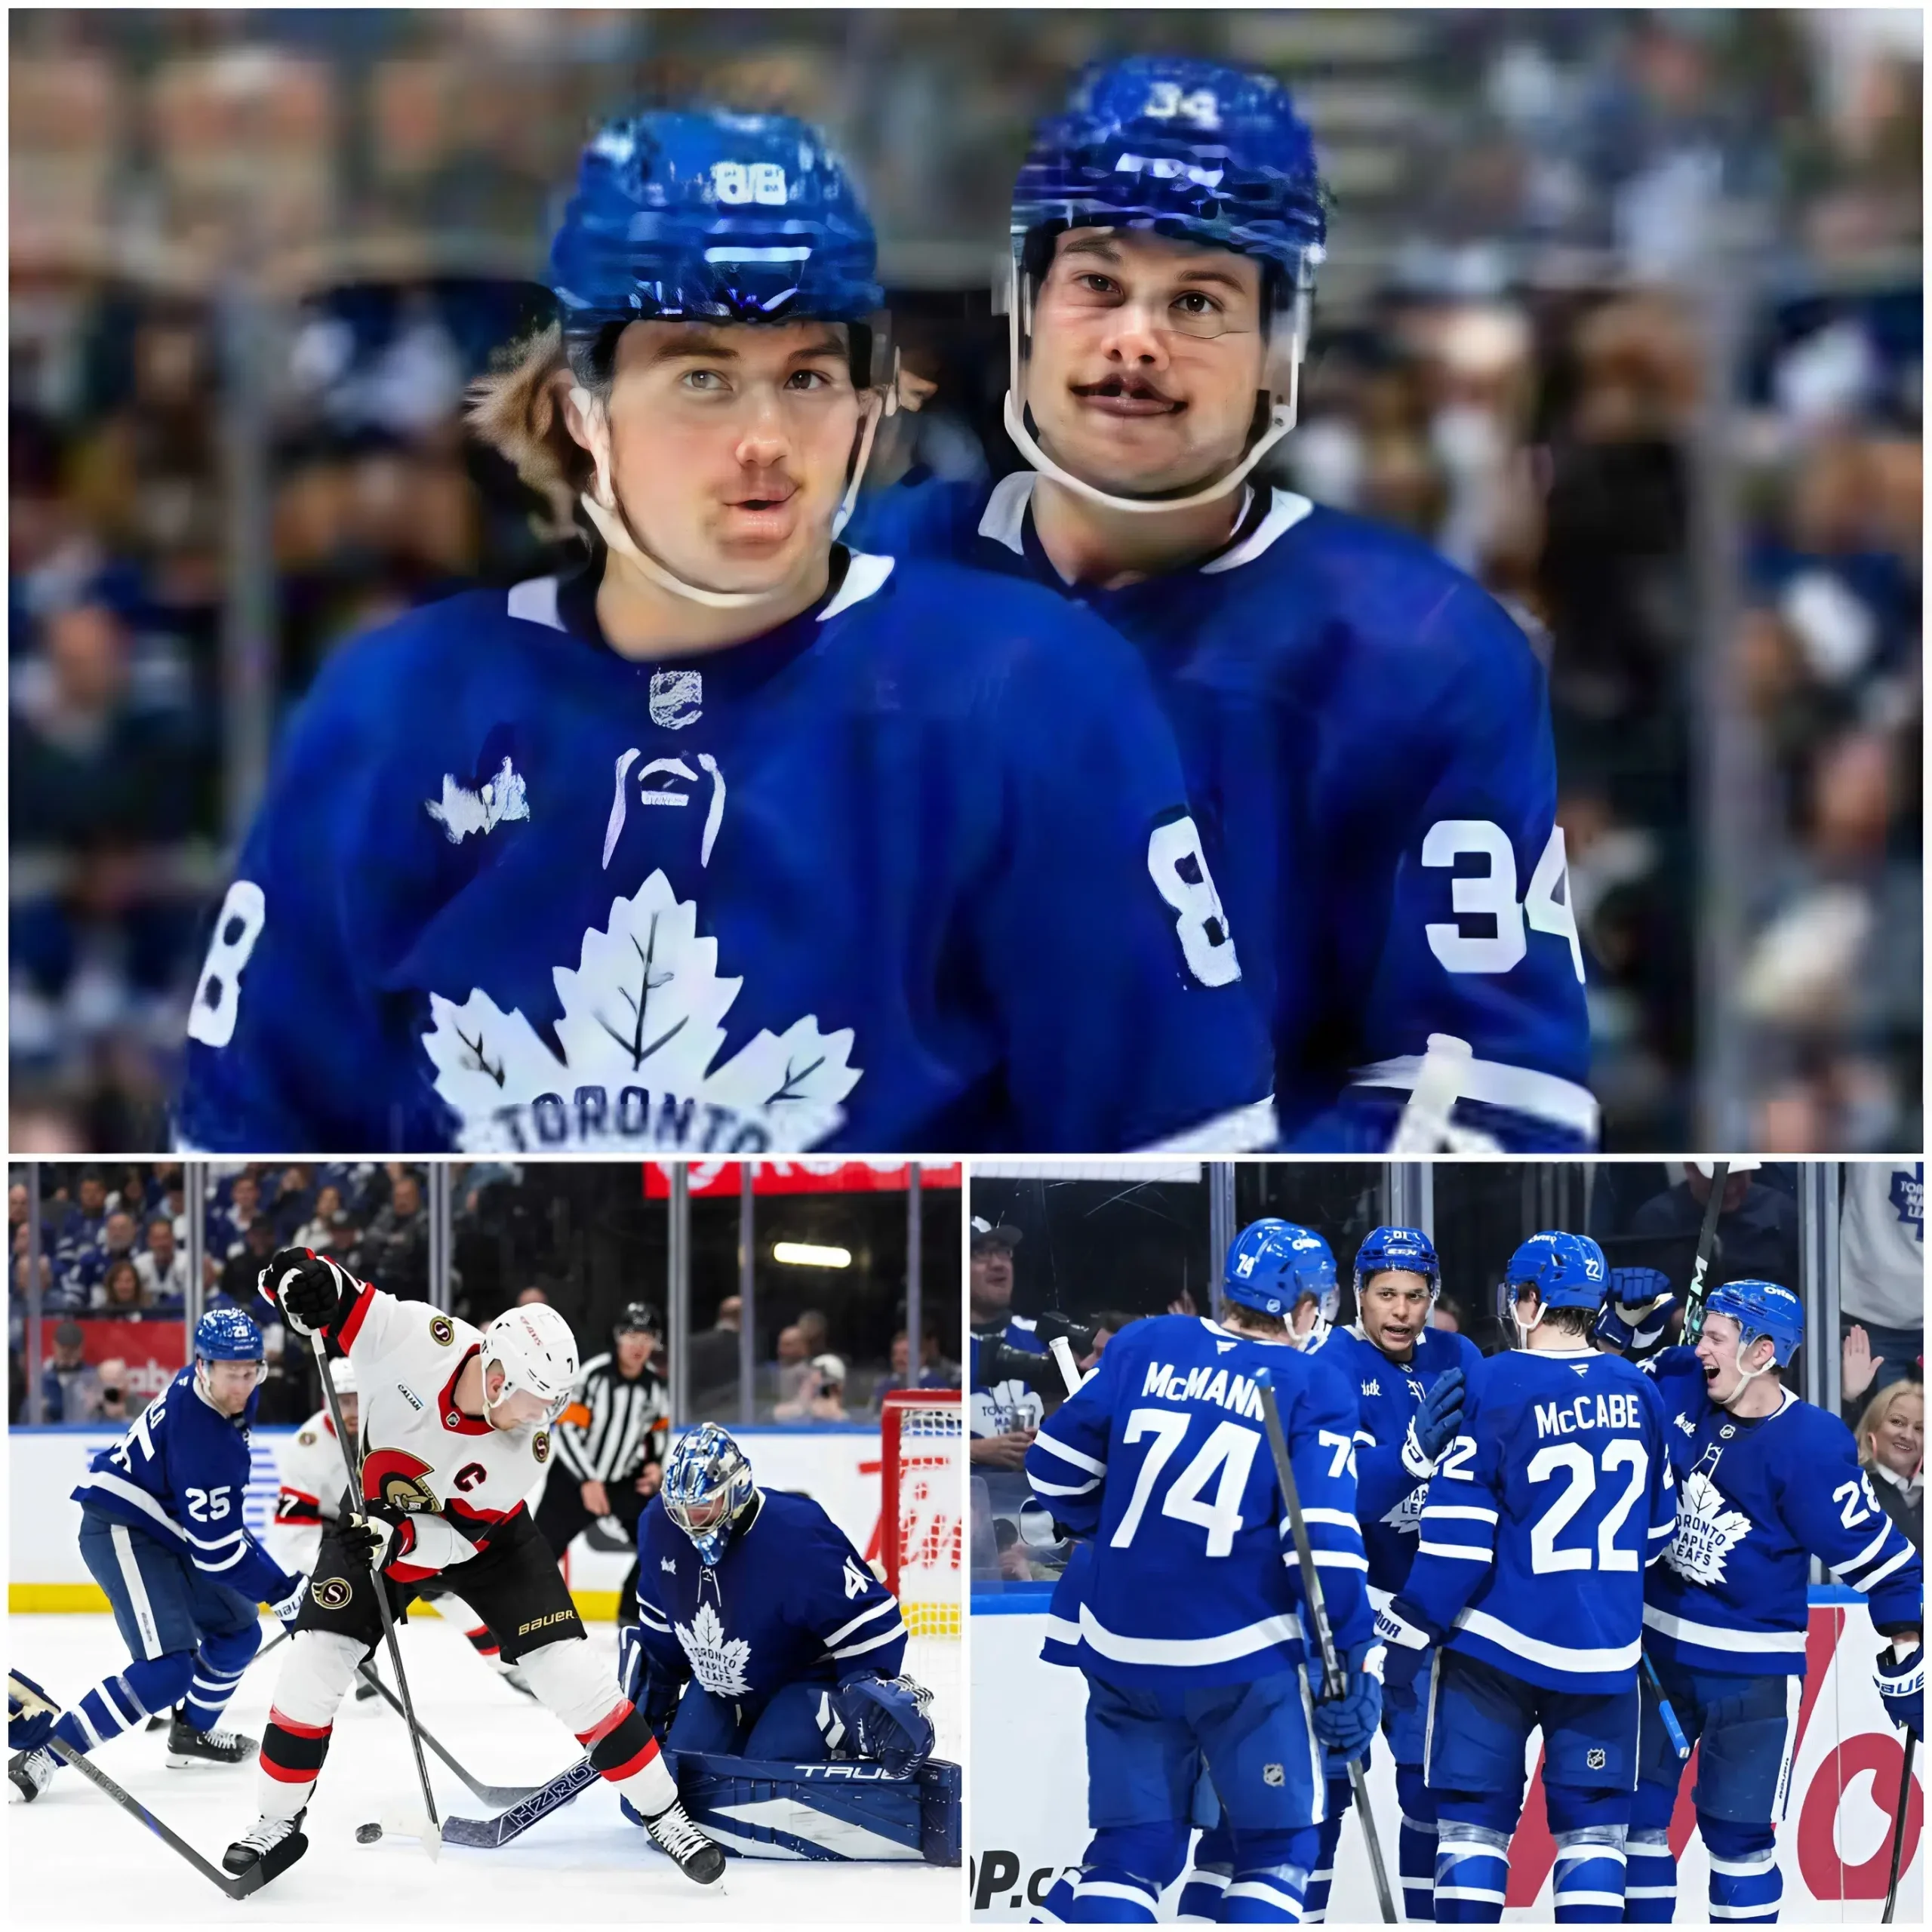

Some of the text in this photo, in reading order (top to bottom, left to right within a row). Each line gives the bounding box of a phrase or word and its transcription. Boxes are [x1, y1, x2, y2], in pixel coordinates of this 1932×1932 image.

[492, 1085, 774, 1152] TORONTO
[1534, 1394, 1641, 1438] McCABE
[453, 1462, 488, 1493] C
[1110, 1408, 1262, 1558] 74
[185, 1485, 231, 1522] 25
[1527, 1438, 1650, 1575] 22
[1675, 1514, 1727, 1546] ORONTO
